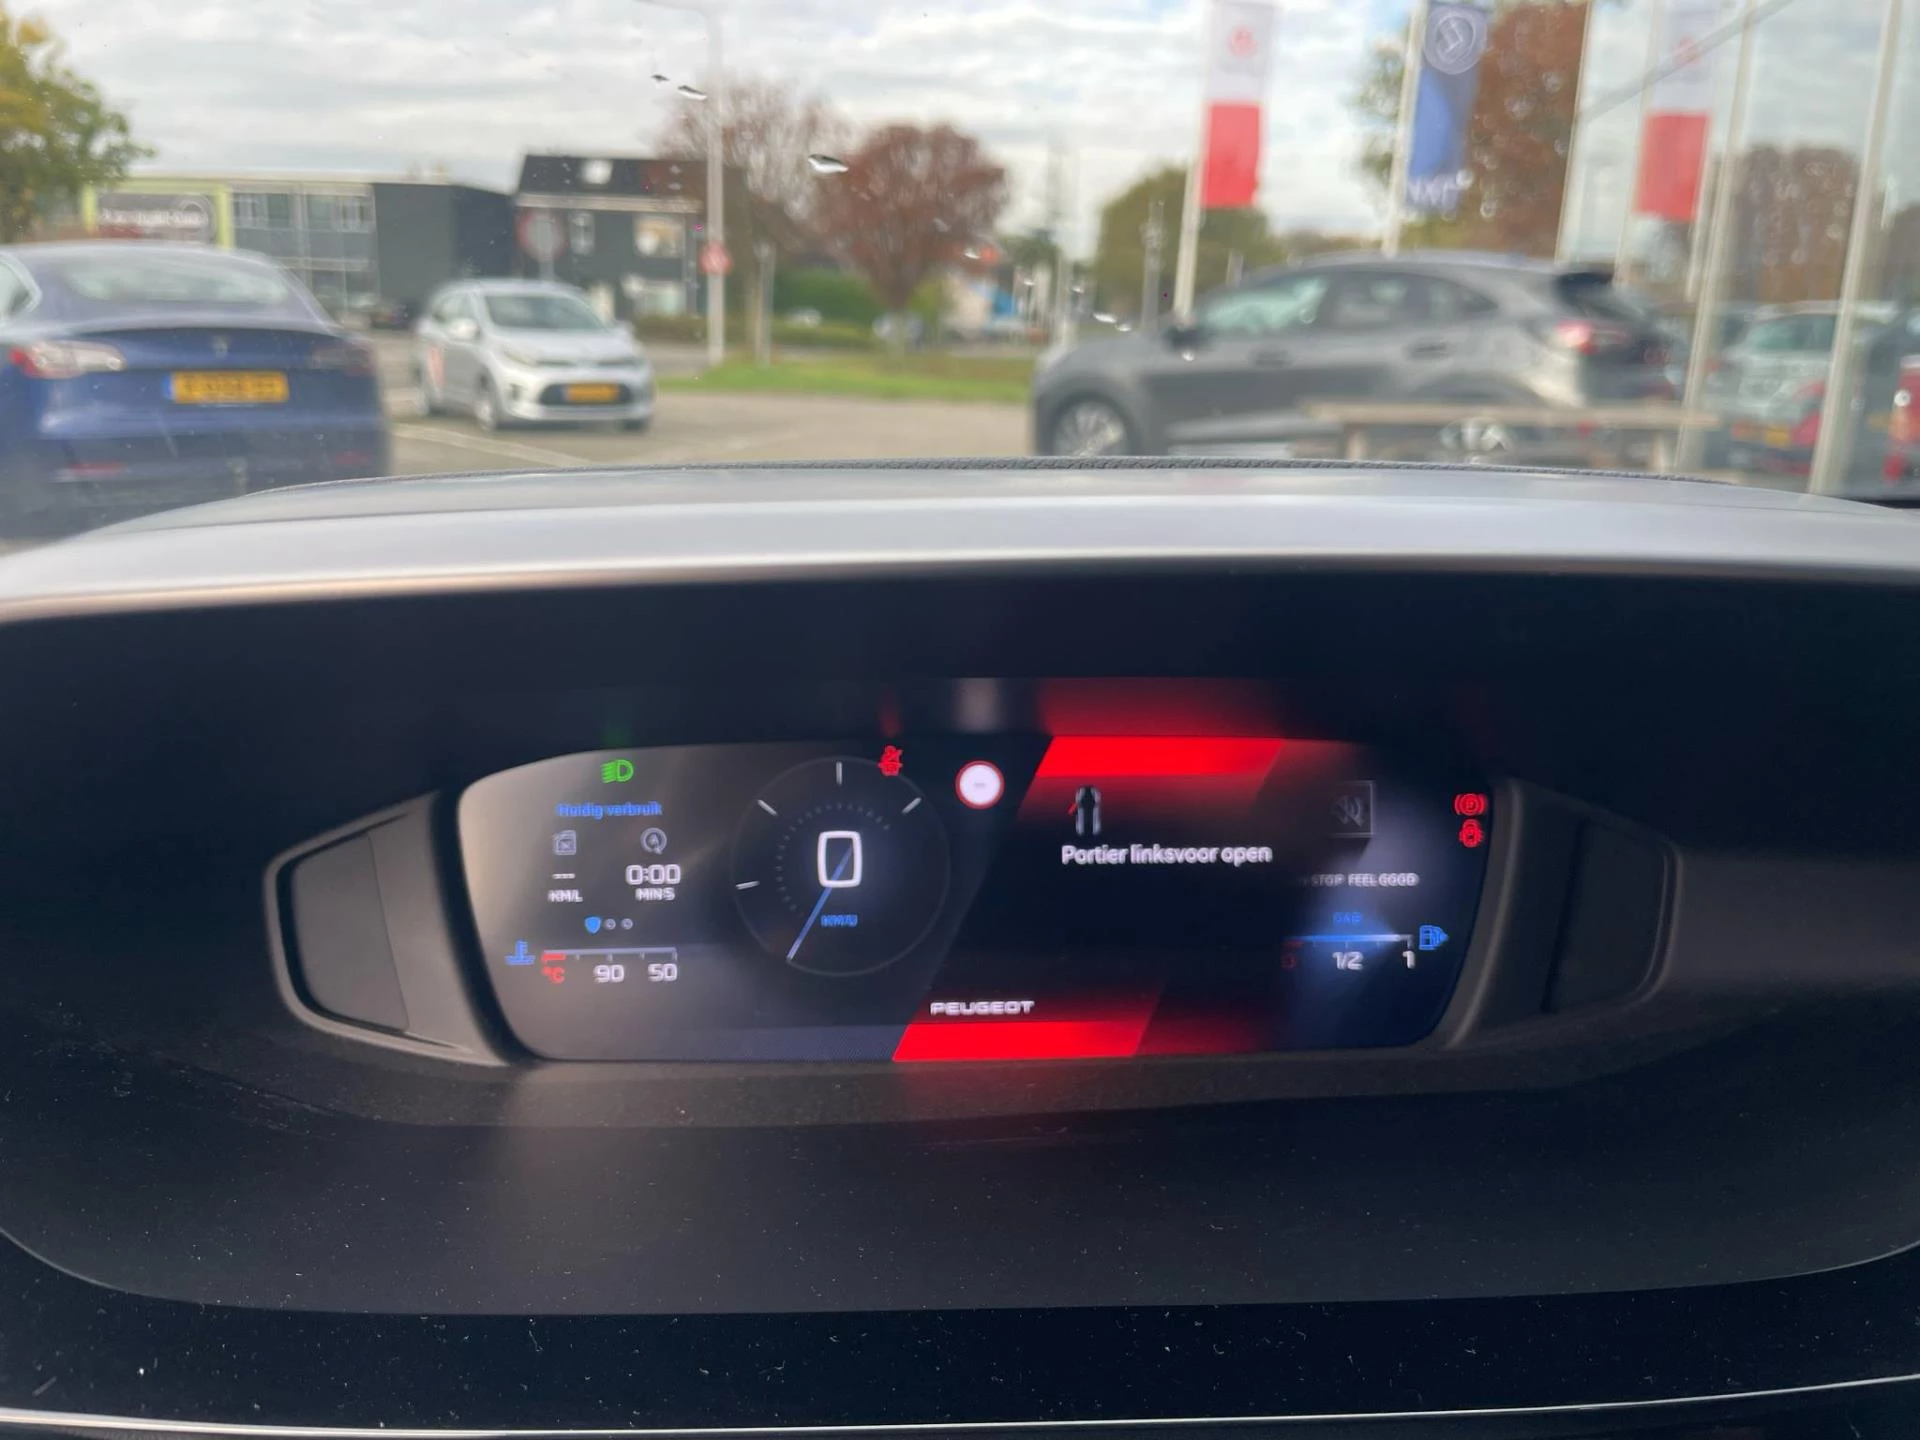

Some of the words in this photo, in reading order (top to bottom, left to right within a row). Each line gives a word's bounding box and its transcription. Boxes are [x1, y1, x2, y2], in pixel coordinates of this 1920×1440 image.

[557, 803, 603, 820] Huidig
[606, 802, 662, 816] verbruik
[817, 830, 863, 888] 0
[1061, 844, 1128, 865] Portier
[1130, 843, 1220, 865] linksvoor
[1221, 846, 1273, 867] open
[625, 864, 681, 885] 0:00
[635, 887, 675, 901] MINS
[1332, 951, 1364, 970] 1/2
[1402, 950, 1416, 969] 1
[593, 964, 625, 983] 90
[648, 963, 678, 982] 50
[930, 1000, 1035, 1016] PEUGEOT
